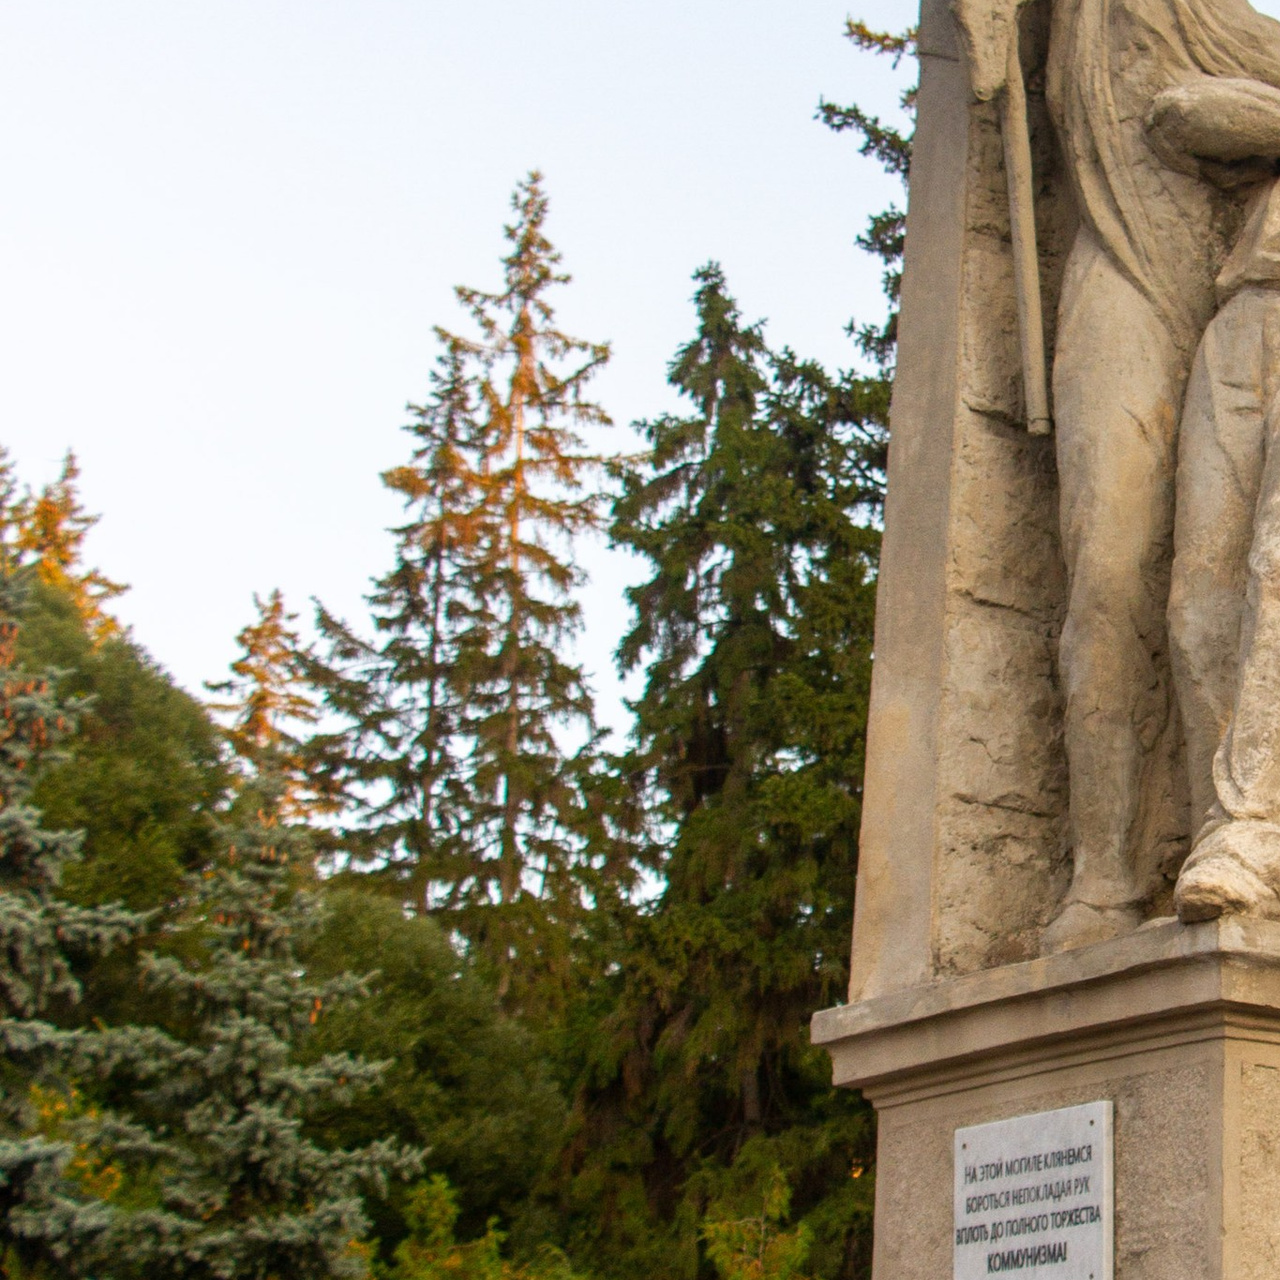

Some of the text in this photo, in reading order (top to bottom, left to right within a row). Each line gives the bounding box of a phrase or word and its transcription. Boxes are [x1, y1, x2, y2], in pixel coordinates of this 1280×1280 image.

[964, 1145, 1092, 1184] НА ЭТОЙ МОГИЛЕ КЛЯНЕМСЯ
[966, 1190, 1010, 1214] БОРОТЬСЯ
[1074, 1176, 1090, 1196] РУК
[956, 1205, 1101, 1246] ВПЛОТЬ ДО ПОЛНОГО ТОРЖЕСТВА
[987, 1241, 1067, 1274] КОММУНИЗМА!
